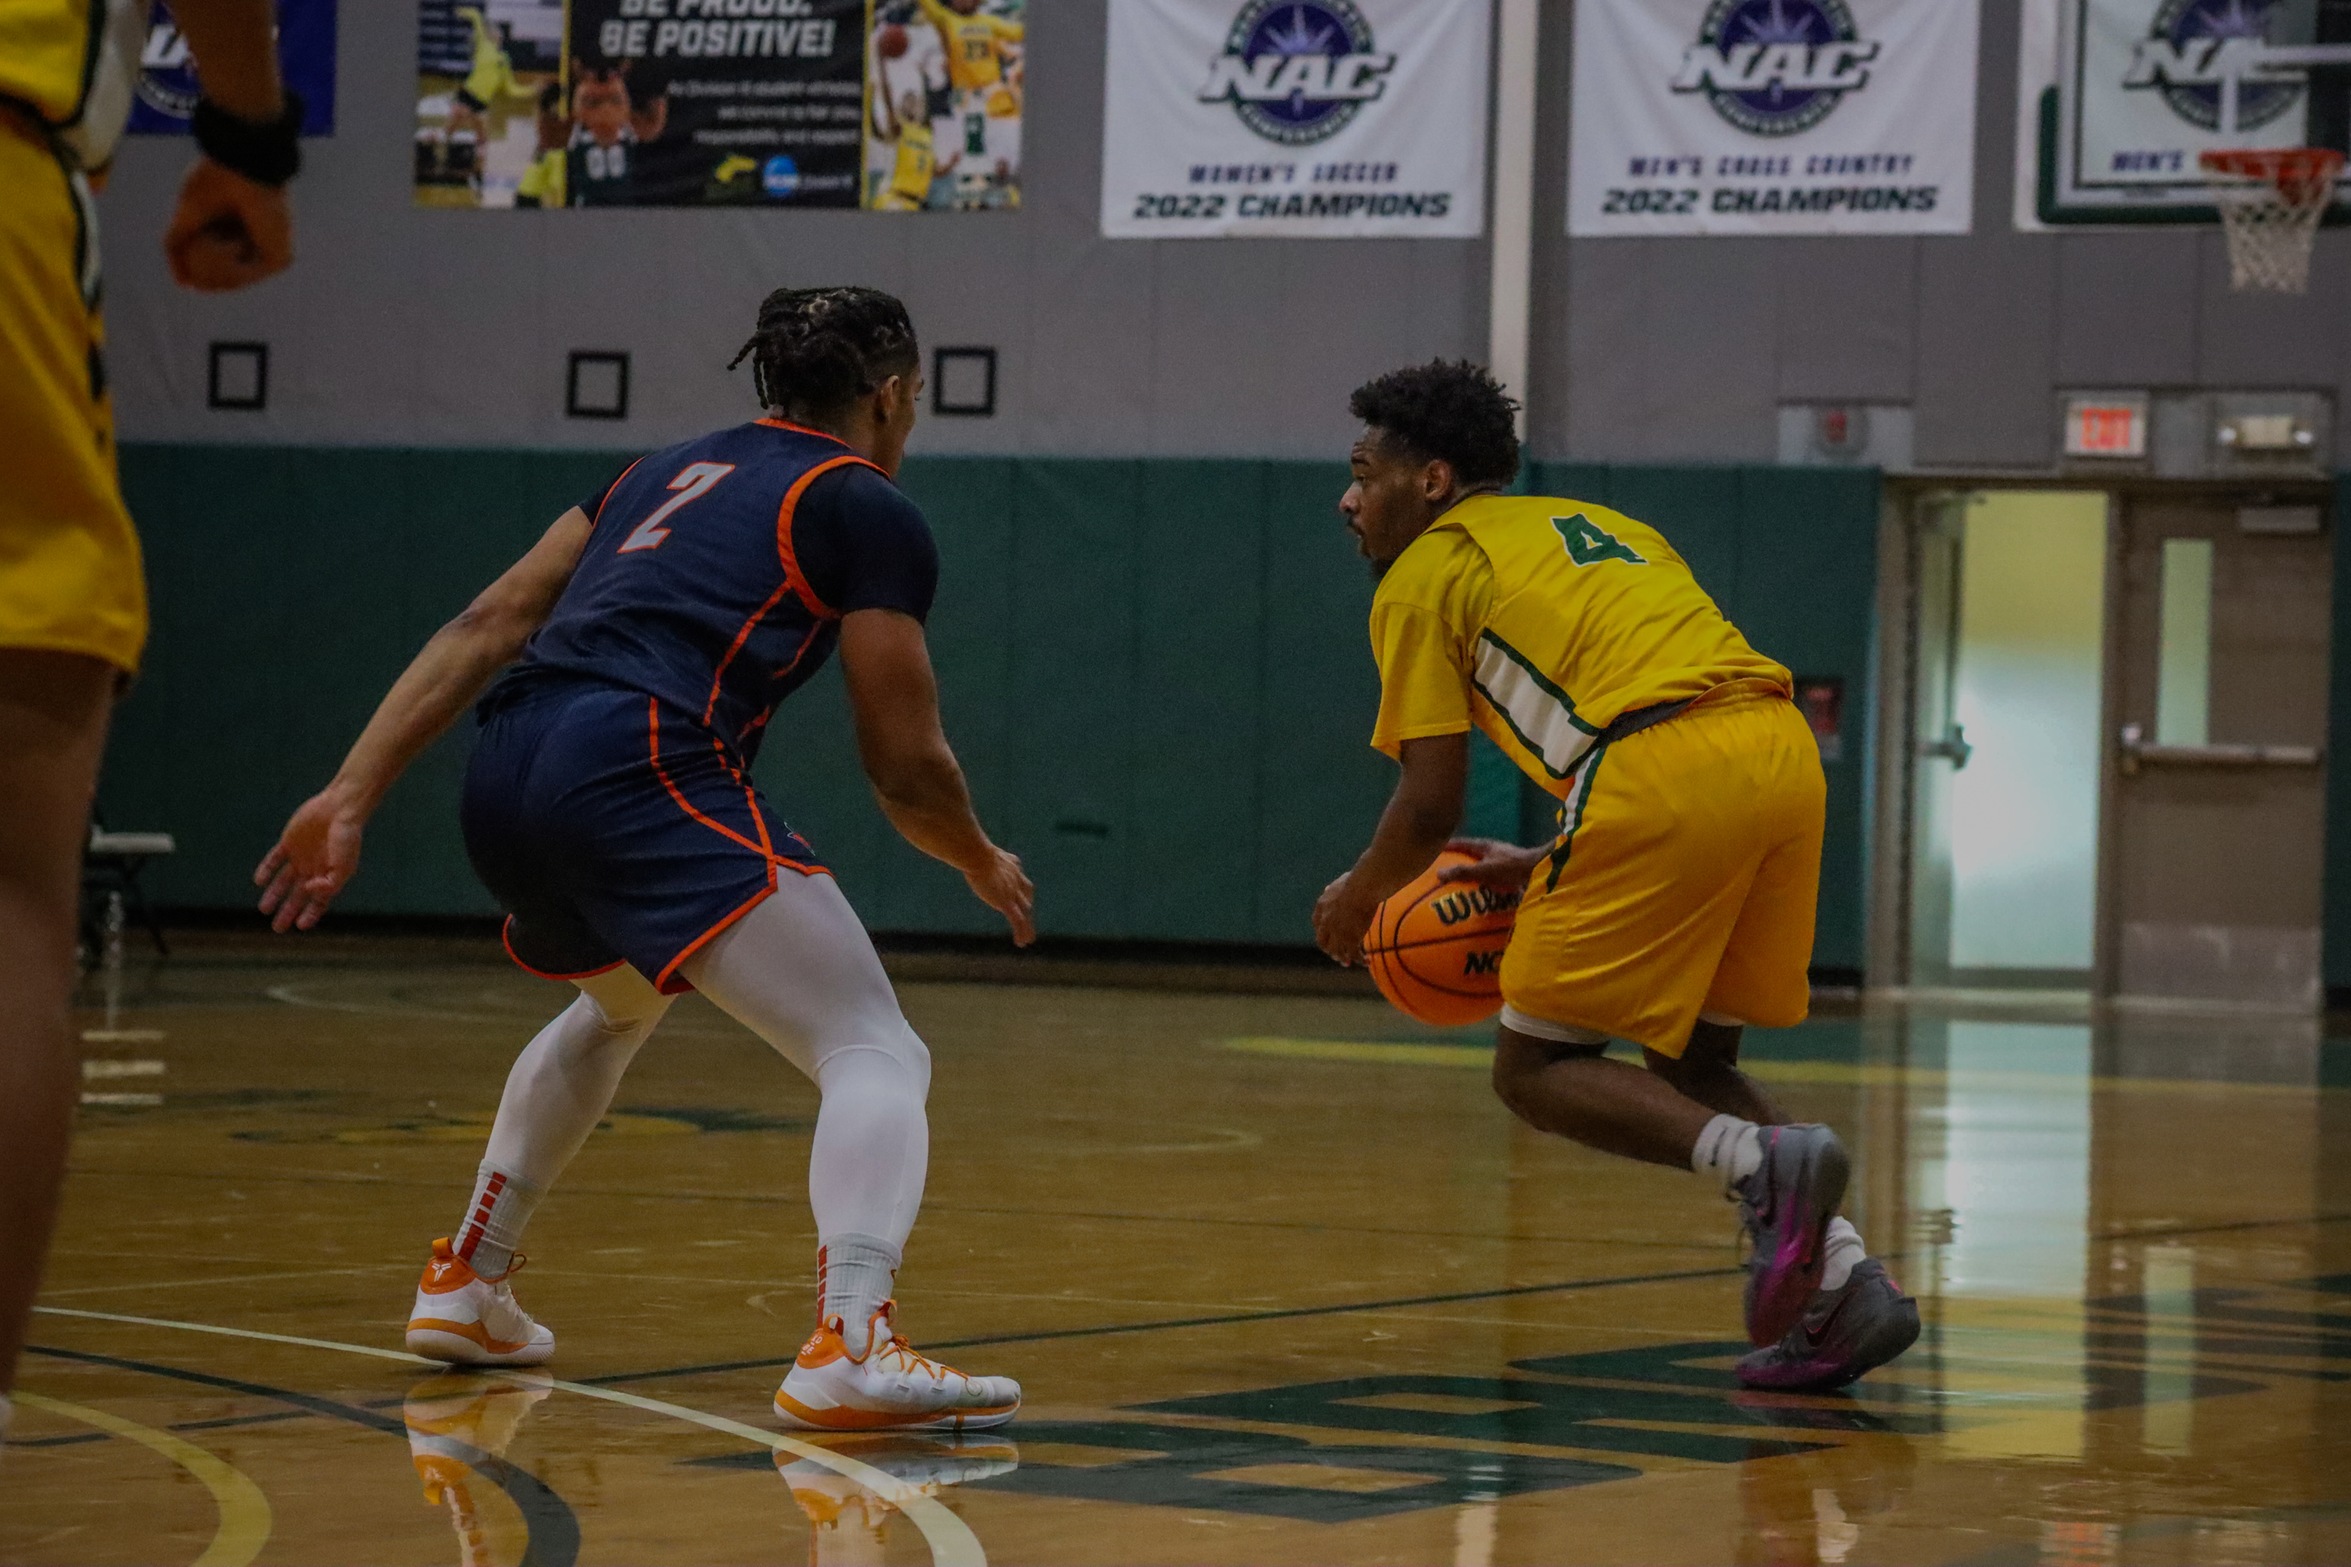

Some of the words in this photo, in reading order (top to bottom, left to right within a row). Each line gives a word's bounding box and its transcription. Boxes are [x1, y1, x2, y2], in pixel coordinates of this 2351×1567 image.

[600, 18, 652, 58] BE
[653, 18, 837, 58] POSITIVE!
[1199, 52, 1397, 102] NAC
[1671, 41, 1882, 93] NAC
[1133, 193, 1226, 219] 2022
[1236, 191, 1453, 218] CHAMPIONS
[1602, 187, 1699, 214] 2022
[1710, 185, 1939, 213] CHAMPIONS
[616, 461, 737, 555] 2
[1549, 512, 1650, 568] 4
